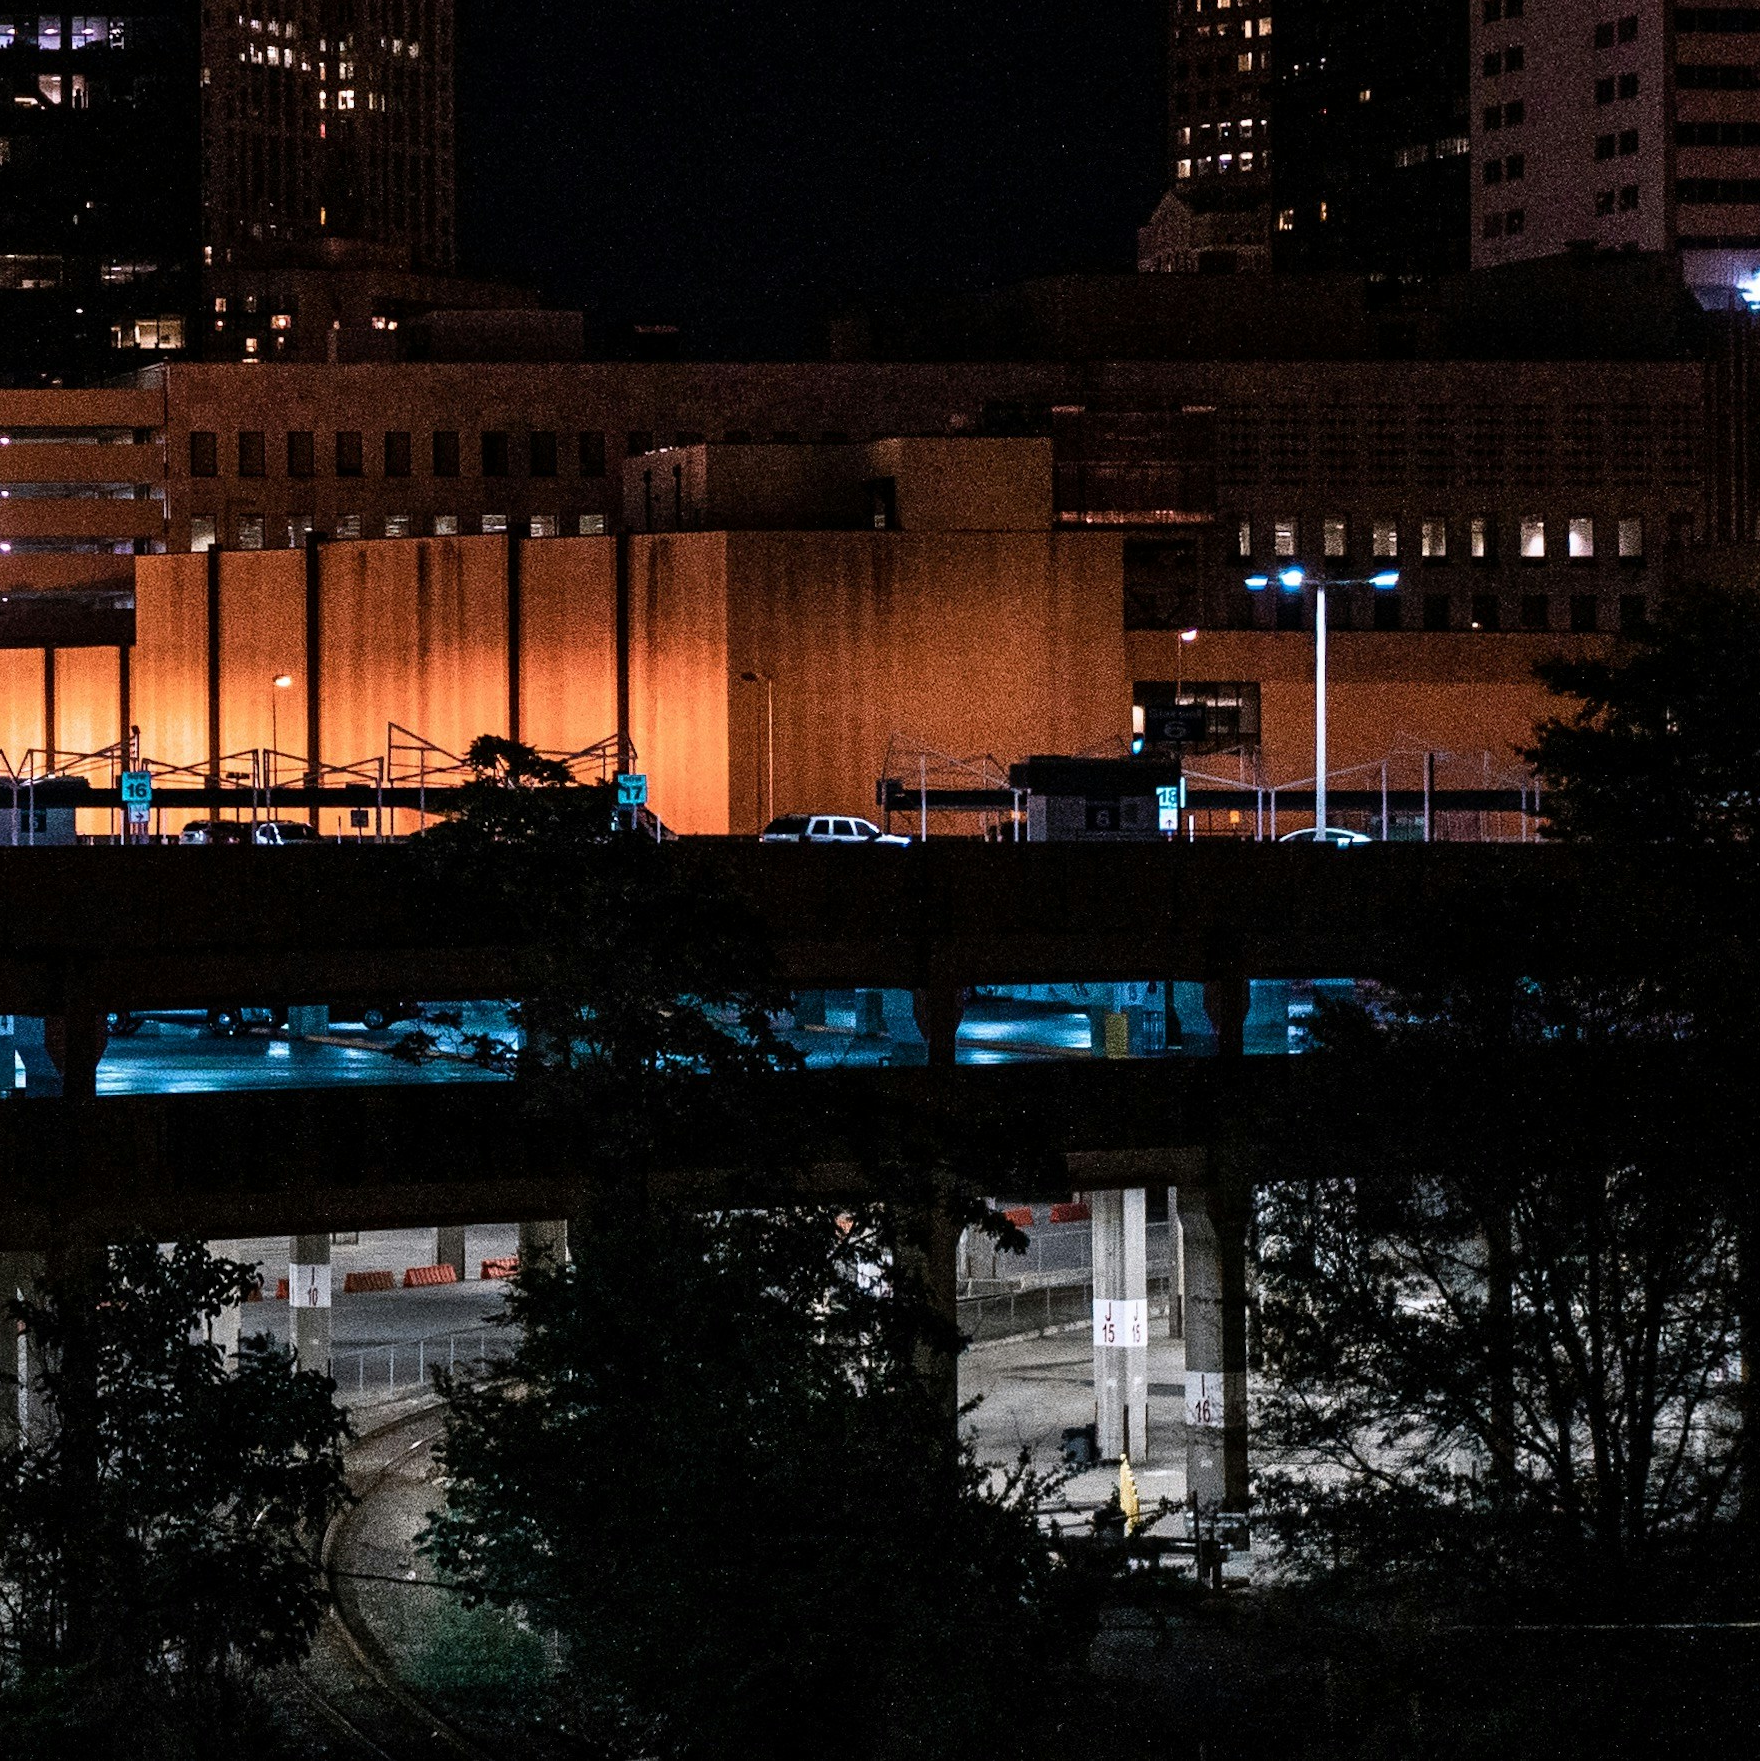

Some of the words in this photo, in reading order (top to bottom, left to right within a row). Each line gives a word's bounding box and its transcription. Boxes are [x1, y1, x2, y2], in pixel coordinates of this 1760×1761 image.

[128, 783, 147, 798] 16
[1160, 789, 1178, 804] 18
[308, 1287, 319, 1307] 10
[1105, 1301, 1112, 1322] J
[1102, 1324, 1115, 1343] 15
[1195, 1399, 1211, 1423] 16
